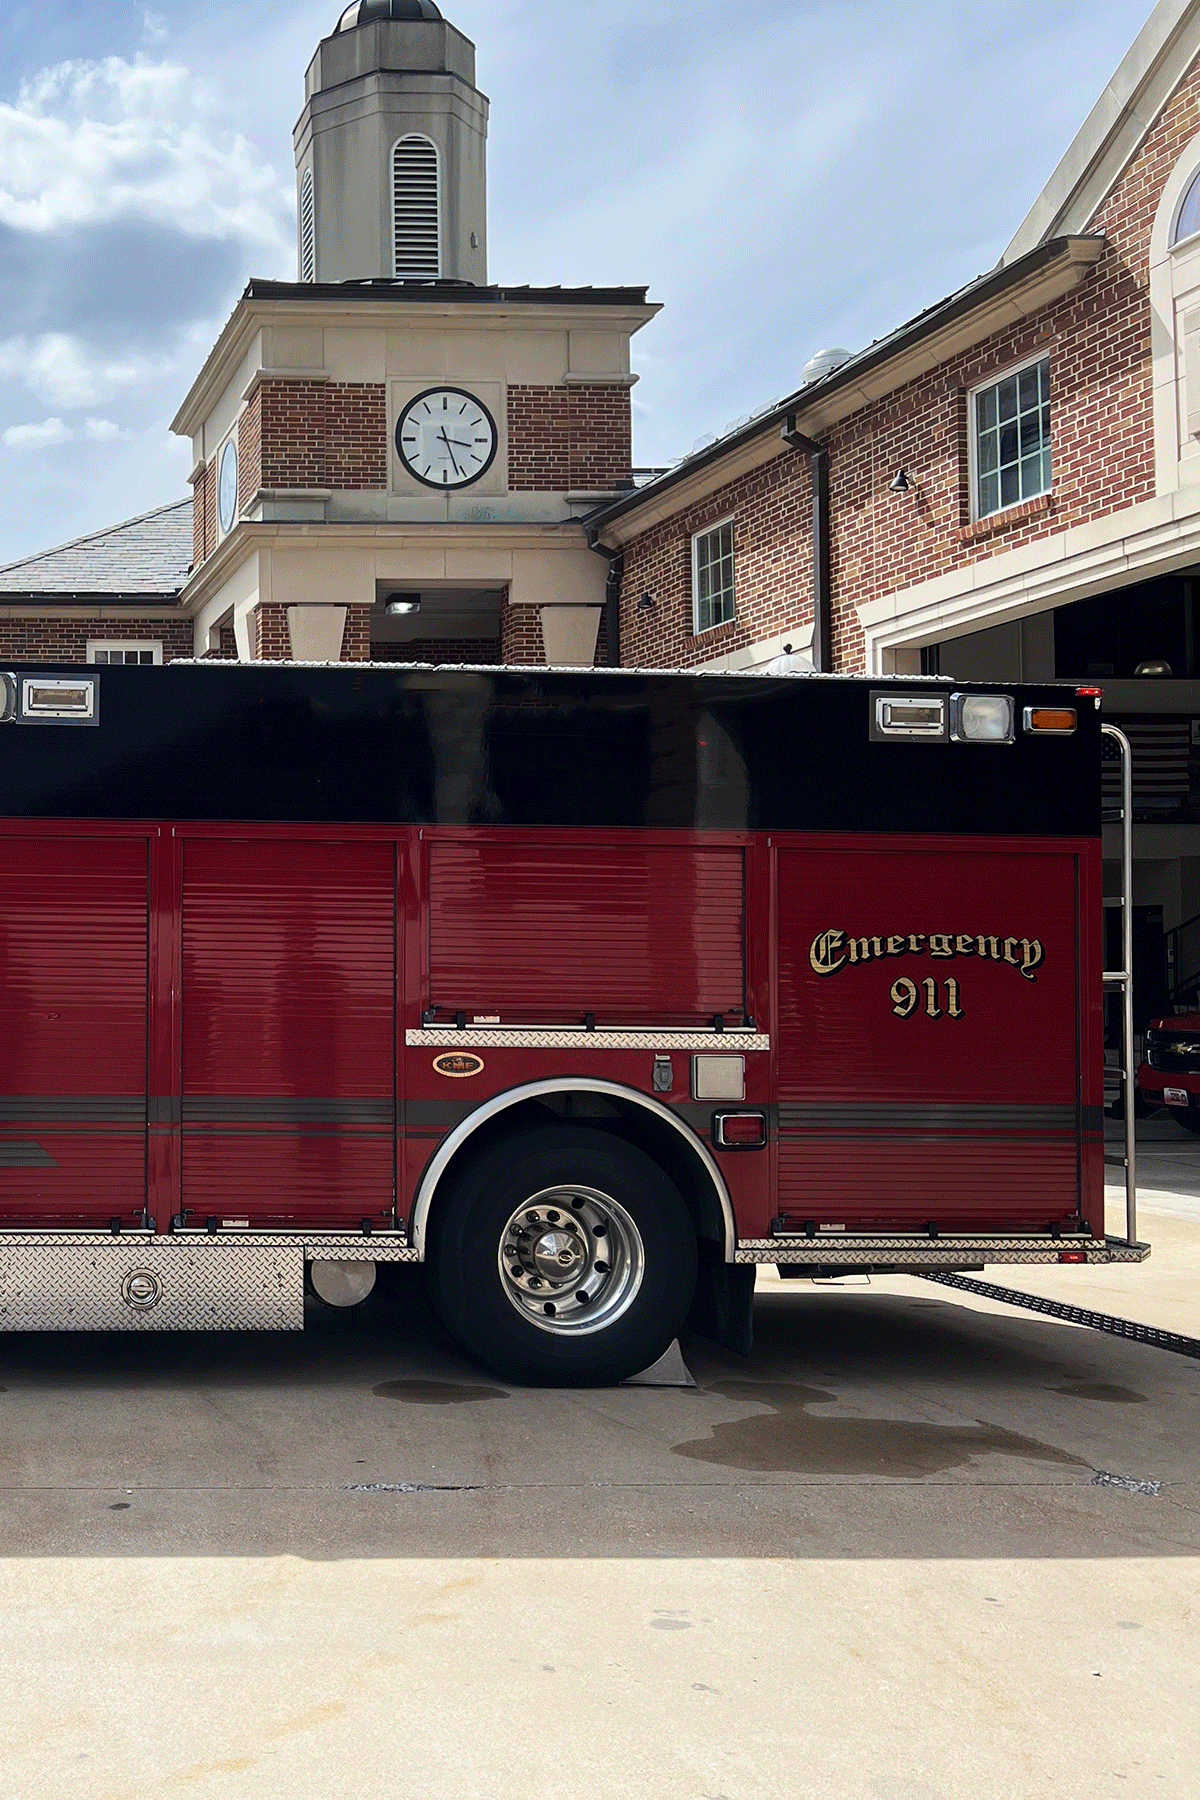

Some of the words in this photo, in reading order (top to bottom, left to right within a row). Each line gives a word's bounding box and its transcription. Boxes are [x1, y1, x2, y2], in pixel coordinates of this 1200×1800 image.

[809, 928, 1045, 981] Emergency
[890, 976, 965, 1019] 911
[442, 1061, 476, 1070] KME
